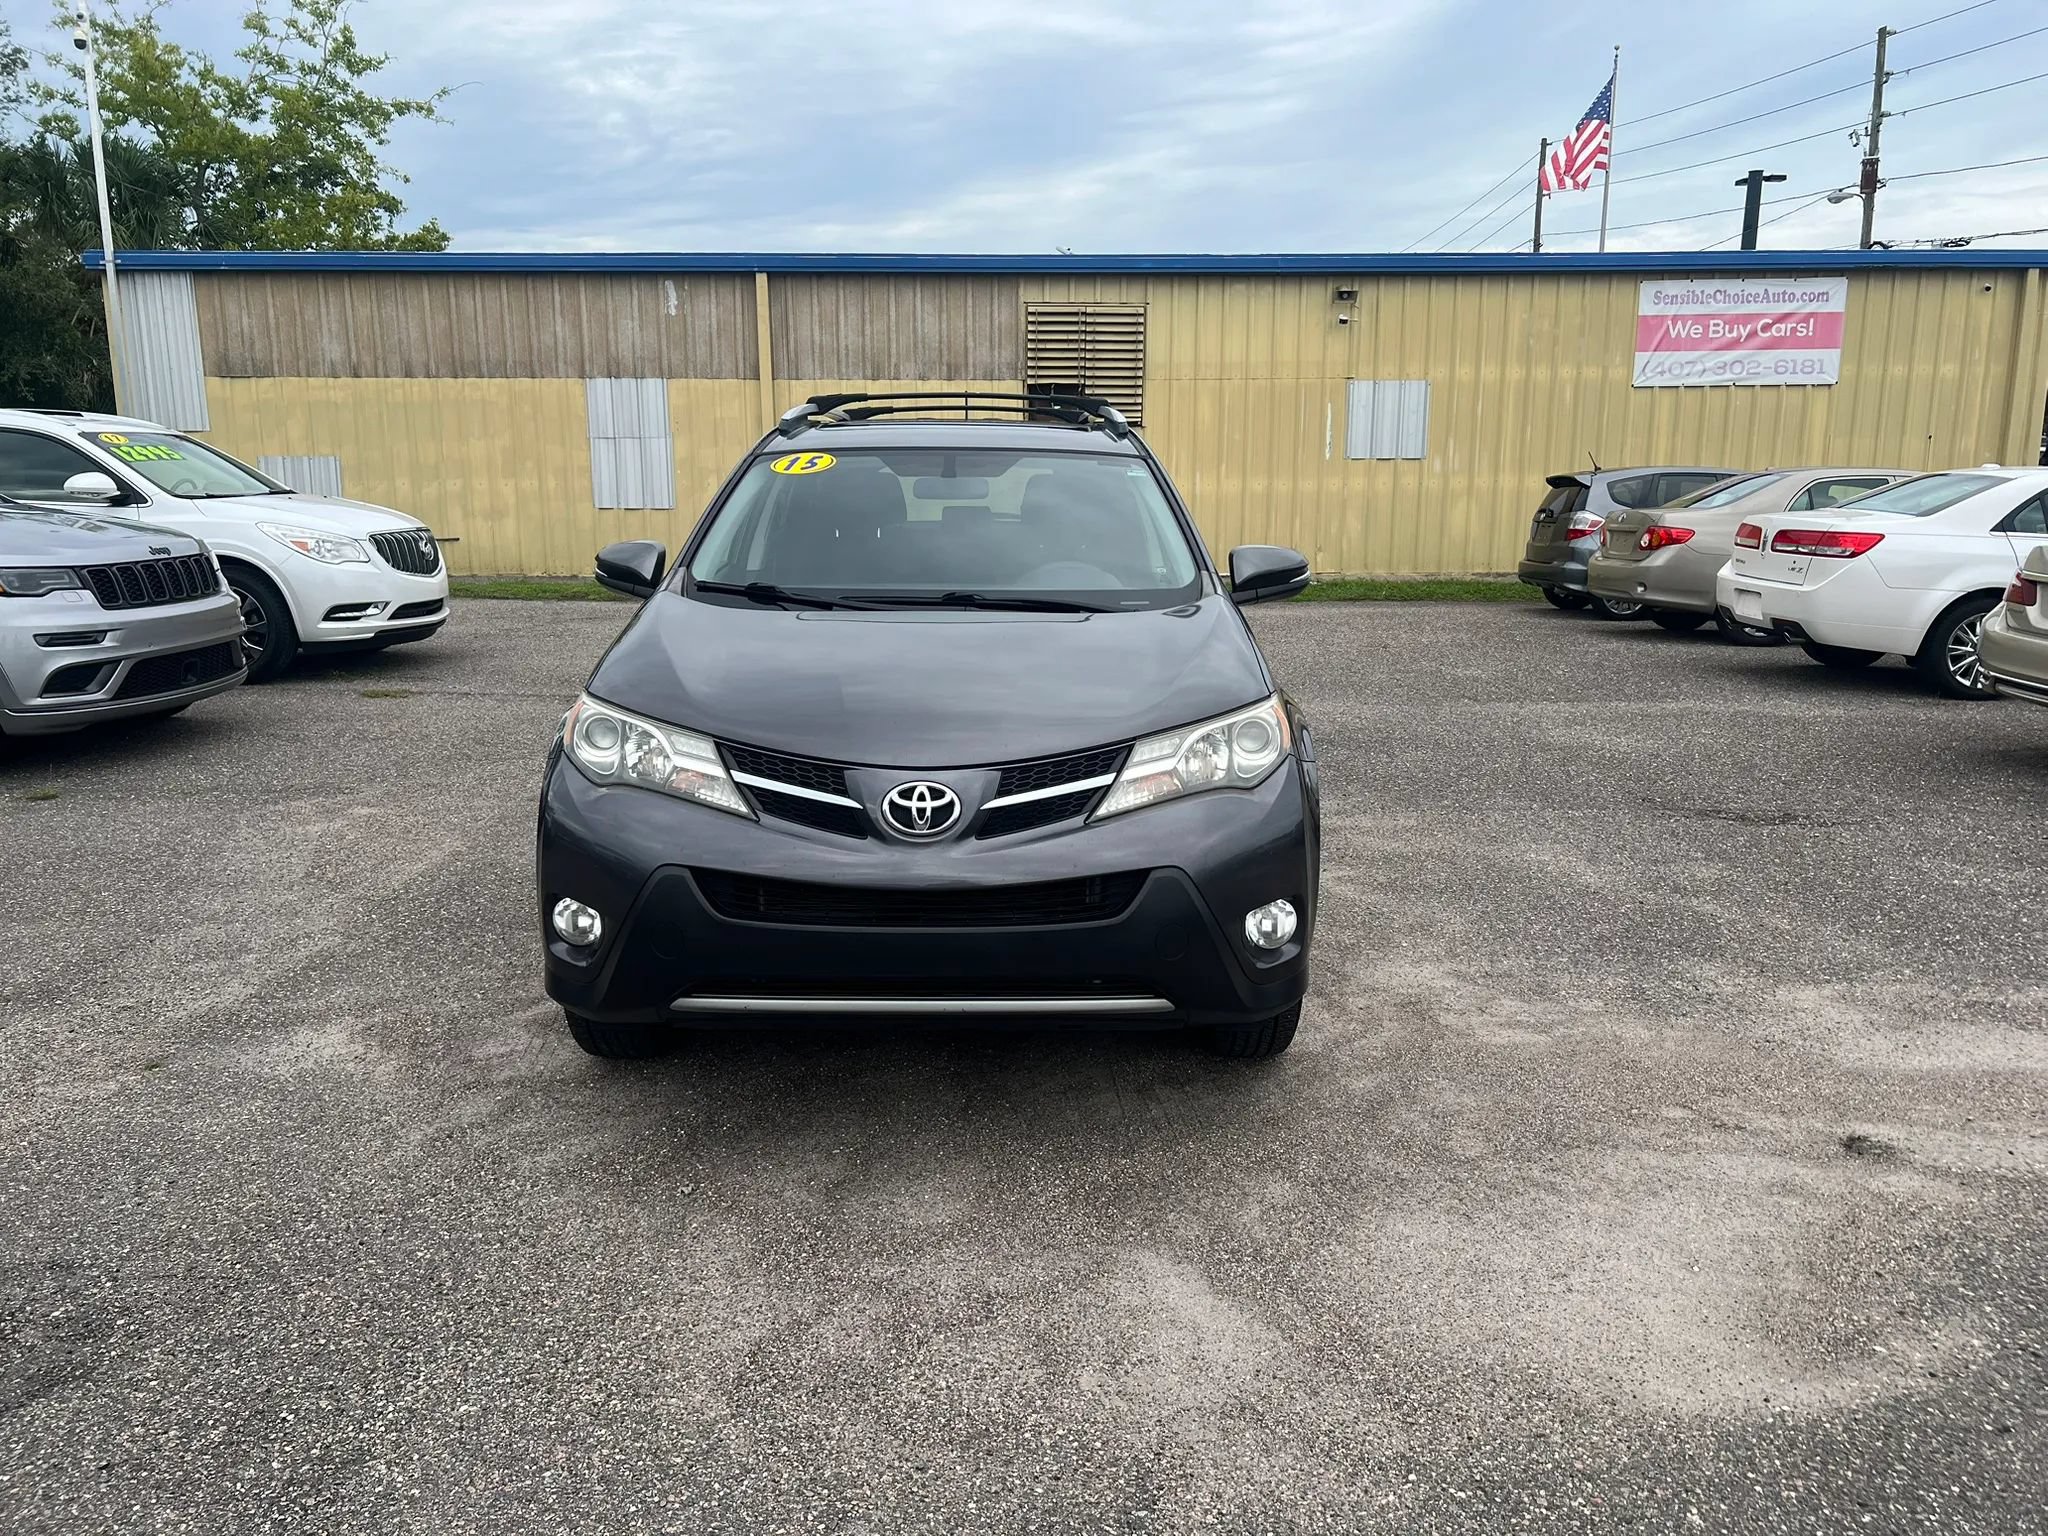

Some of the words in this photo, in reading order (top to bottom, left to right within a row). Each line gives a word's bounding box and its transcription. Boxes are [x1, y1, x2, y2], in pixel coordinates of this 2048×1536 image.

[1653, 288, 1830, 306] SensibleChoiceAuto.com
[1668, 320, 1703, 338] We
[1708, 320, 1751, 342] Buy
[1756, 318, 1814, 337] Cars!
[784, 455, 823, 471] 15
[148, 545, 171, 556] Jeep
